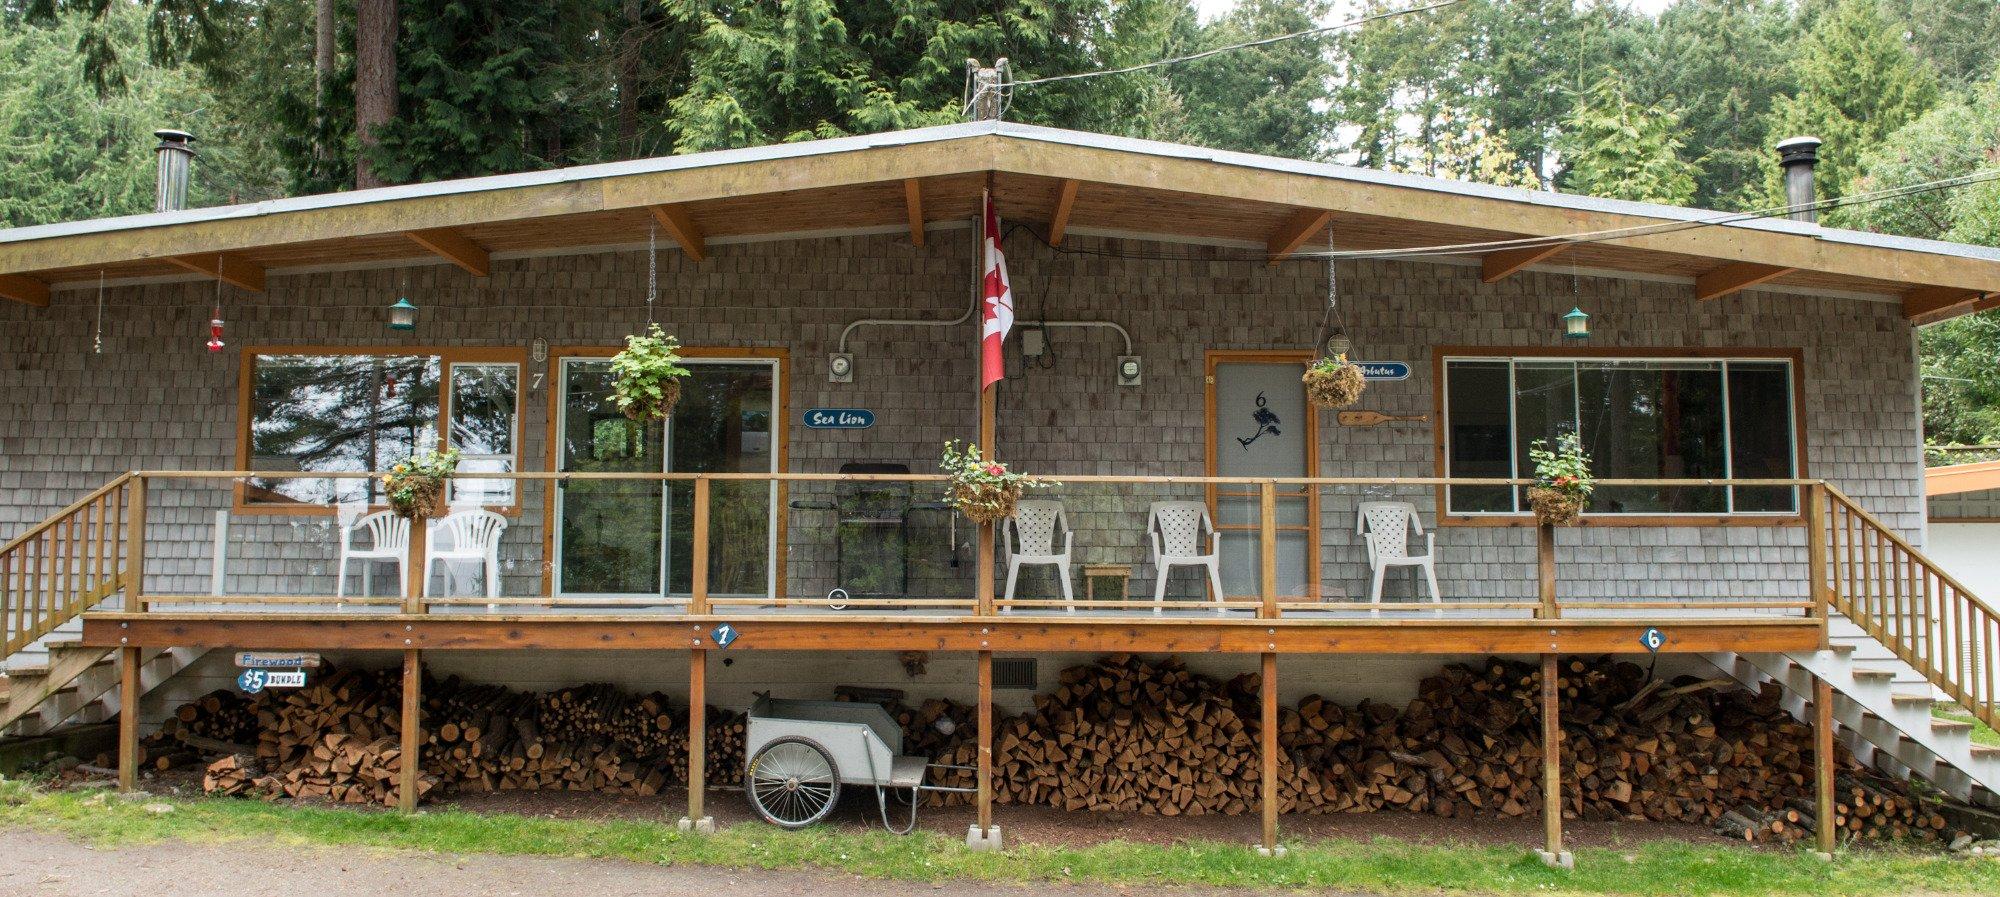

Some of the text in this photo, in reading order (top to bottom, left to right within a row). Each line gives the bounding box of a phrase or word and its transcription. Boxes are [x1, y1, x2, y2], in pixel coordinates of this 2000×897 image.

[533, 373, 544, 389] 7
[1255, 390, 1266, 407] 6
[813, 411, 865, 425] Sea Lion
[1648, 629, 1660, 648] 6
[243, 653, 302, 666] Firewood
[245, 669, 302, 688] $5 BUNDLE
